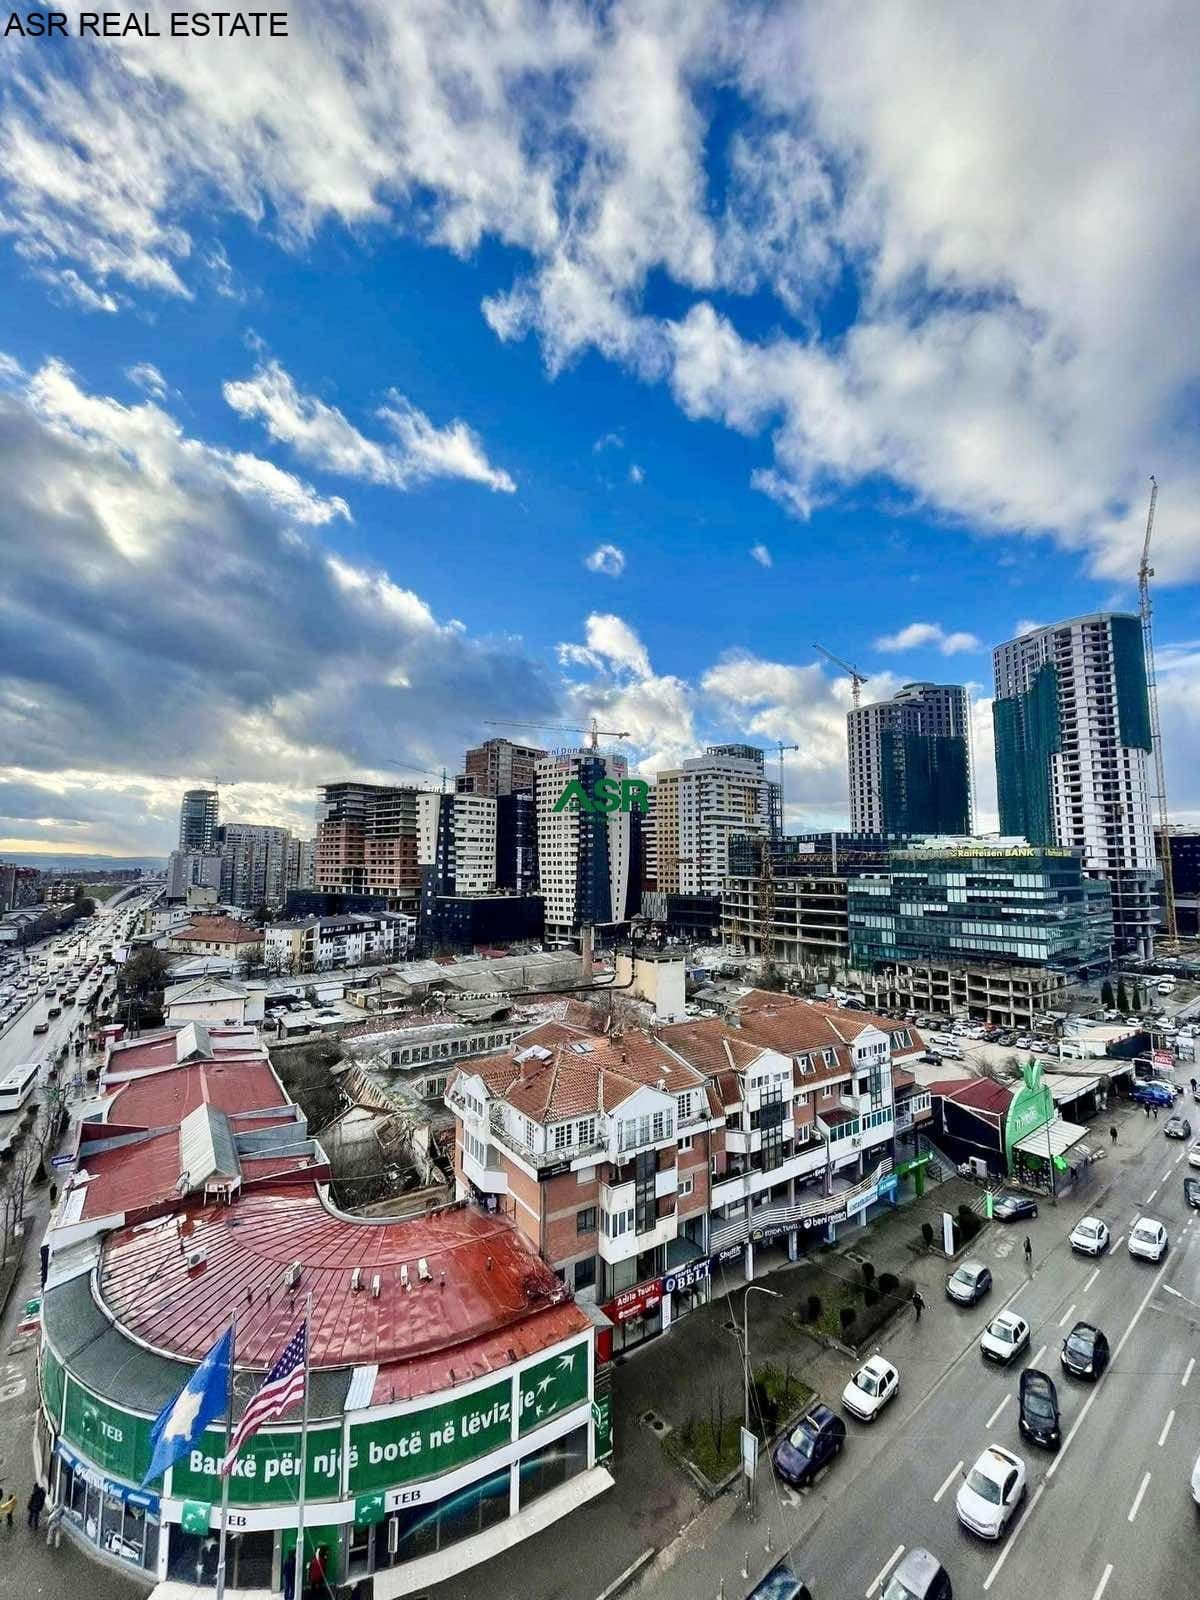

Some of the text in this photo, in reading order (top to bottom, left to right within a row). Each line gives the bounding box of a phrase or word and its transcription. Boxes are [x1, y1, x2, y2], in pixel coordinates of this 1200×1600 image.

[958, 848, 1003, 857] Raiffeisen
[1005, 847, 1035, 857] BANK
[101, 1421, 123, 1442] TEB
[369, 1431, 422, 1464] botë
[429, 1423, 455, 1448] në
[392, 1490, 421, 1506] TEB
[227, 1514, 247, 1527] EB
